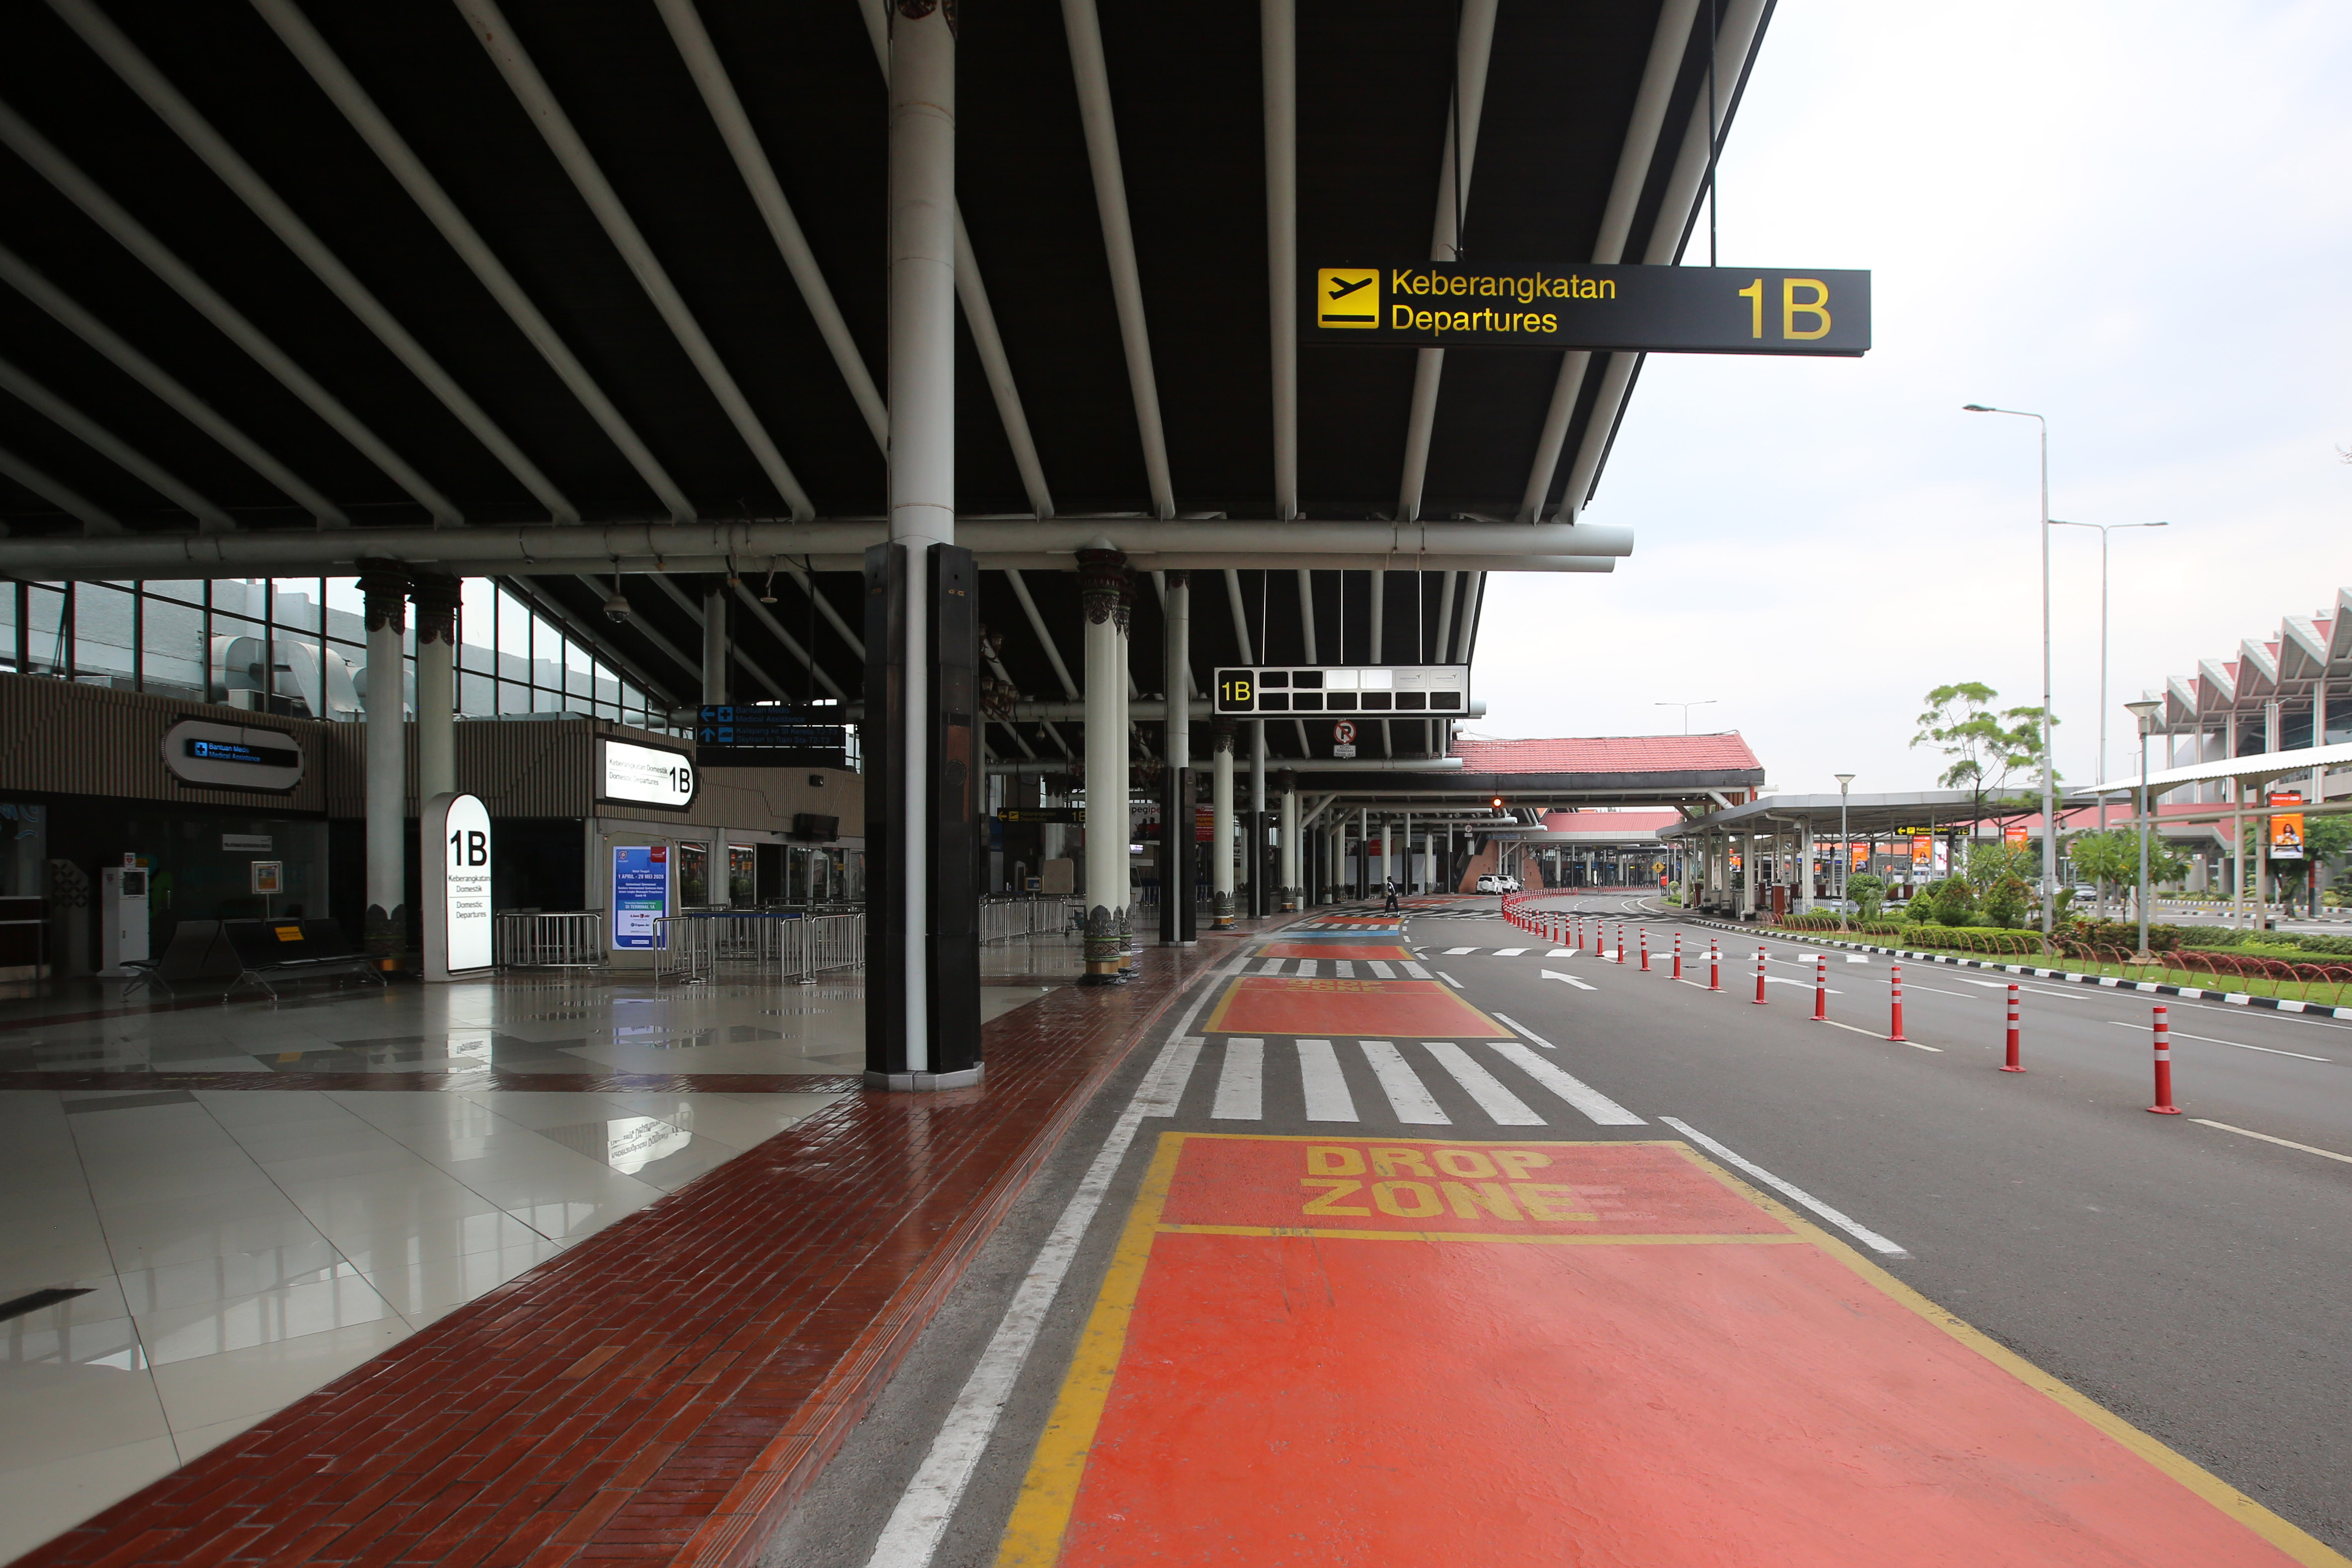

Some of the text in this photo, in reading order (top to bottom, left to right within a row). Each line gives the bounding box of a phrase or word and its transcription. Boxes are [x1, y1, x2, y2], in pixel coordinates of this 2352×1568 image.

[1392, 269, 1616, 303] Keberangkatan
[1392, 304, 1558, 337] Departures
[1738, 278, 1832, 340] 1B
[1222, 681, 1251, 701] 1B
[209, 743, 232, 751] Bantuan
[232, 753, 261, 762] Assistance
[609, 758, 668, 774] Keberangkatan Domestik
[633, 775, 659, 786] Departures
[669, 766, 690, 793] 1B
[450, 830, 487, 866] 1B
[449, 874, 490, 883] Keberangkatan
[456, 911, 487, 920] Departures
[1306, 1146, 1553, 1179] DROP
[1300, 1178, 1601, 1222] ZONE
